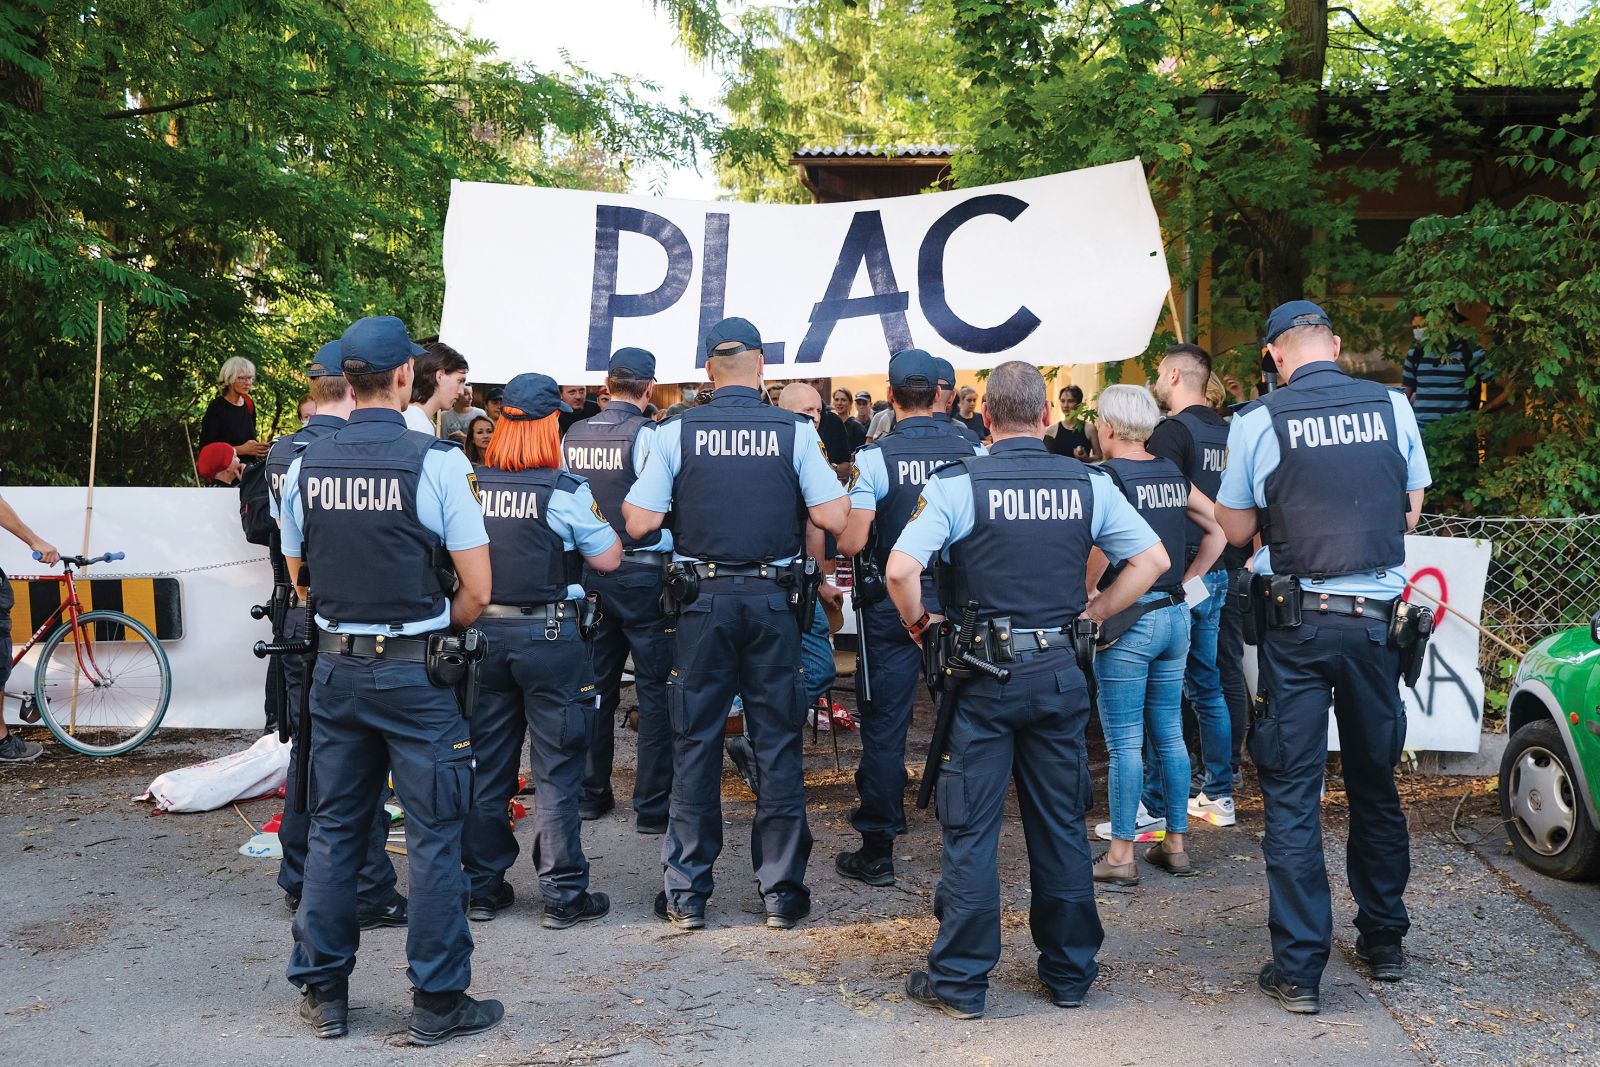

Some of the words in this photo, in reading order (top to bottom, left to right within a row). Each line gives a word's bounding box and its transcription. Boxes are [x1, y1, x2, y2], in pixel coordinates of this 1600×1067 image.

[586, 194, 1042, 371] PLAC
[695, 429, 780, 457] POLICIJA
[1287, 412, 1389, 448] POLICIJA
[568, 447, 623, 470] POLICIJA
[308, 476, 403, 511] POLICIJA
[988, 488, 1083, 520] POLICIJA
[1136, 483, 1188, 510] POLICIJA
